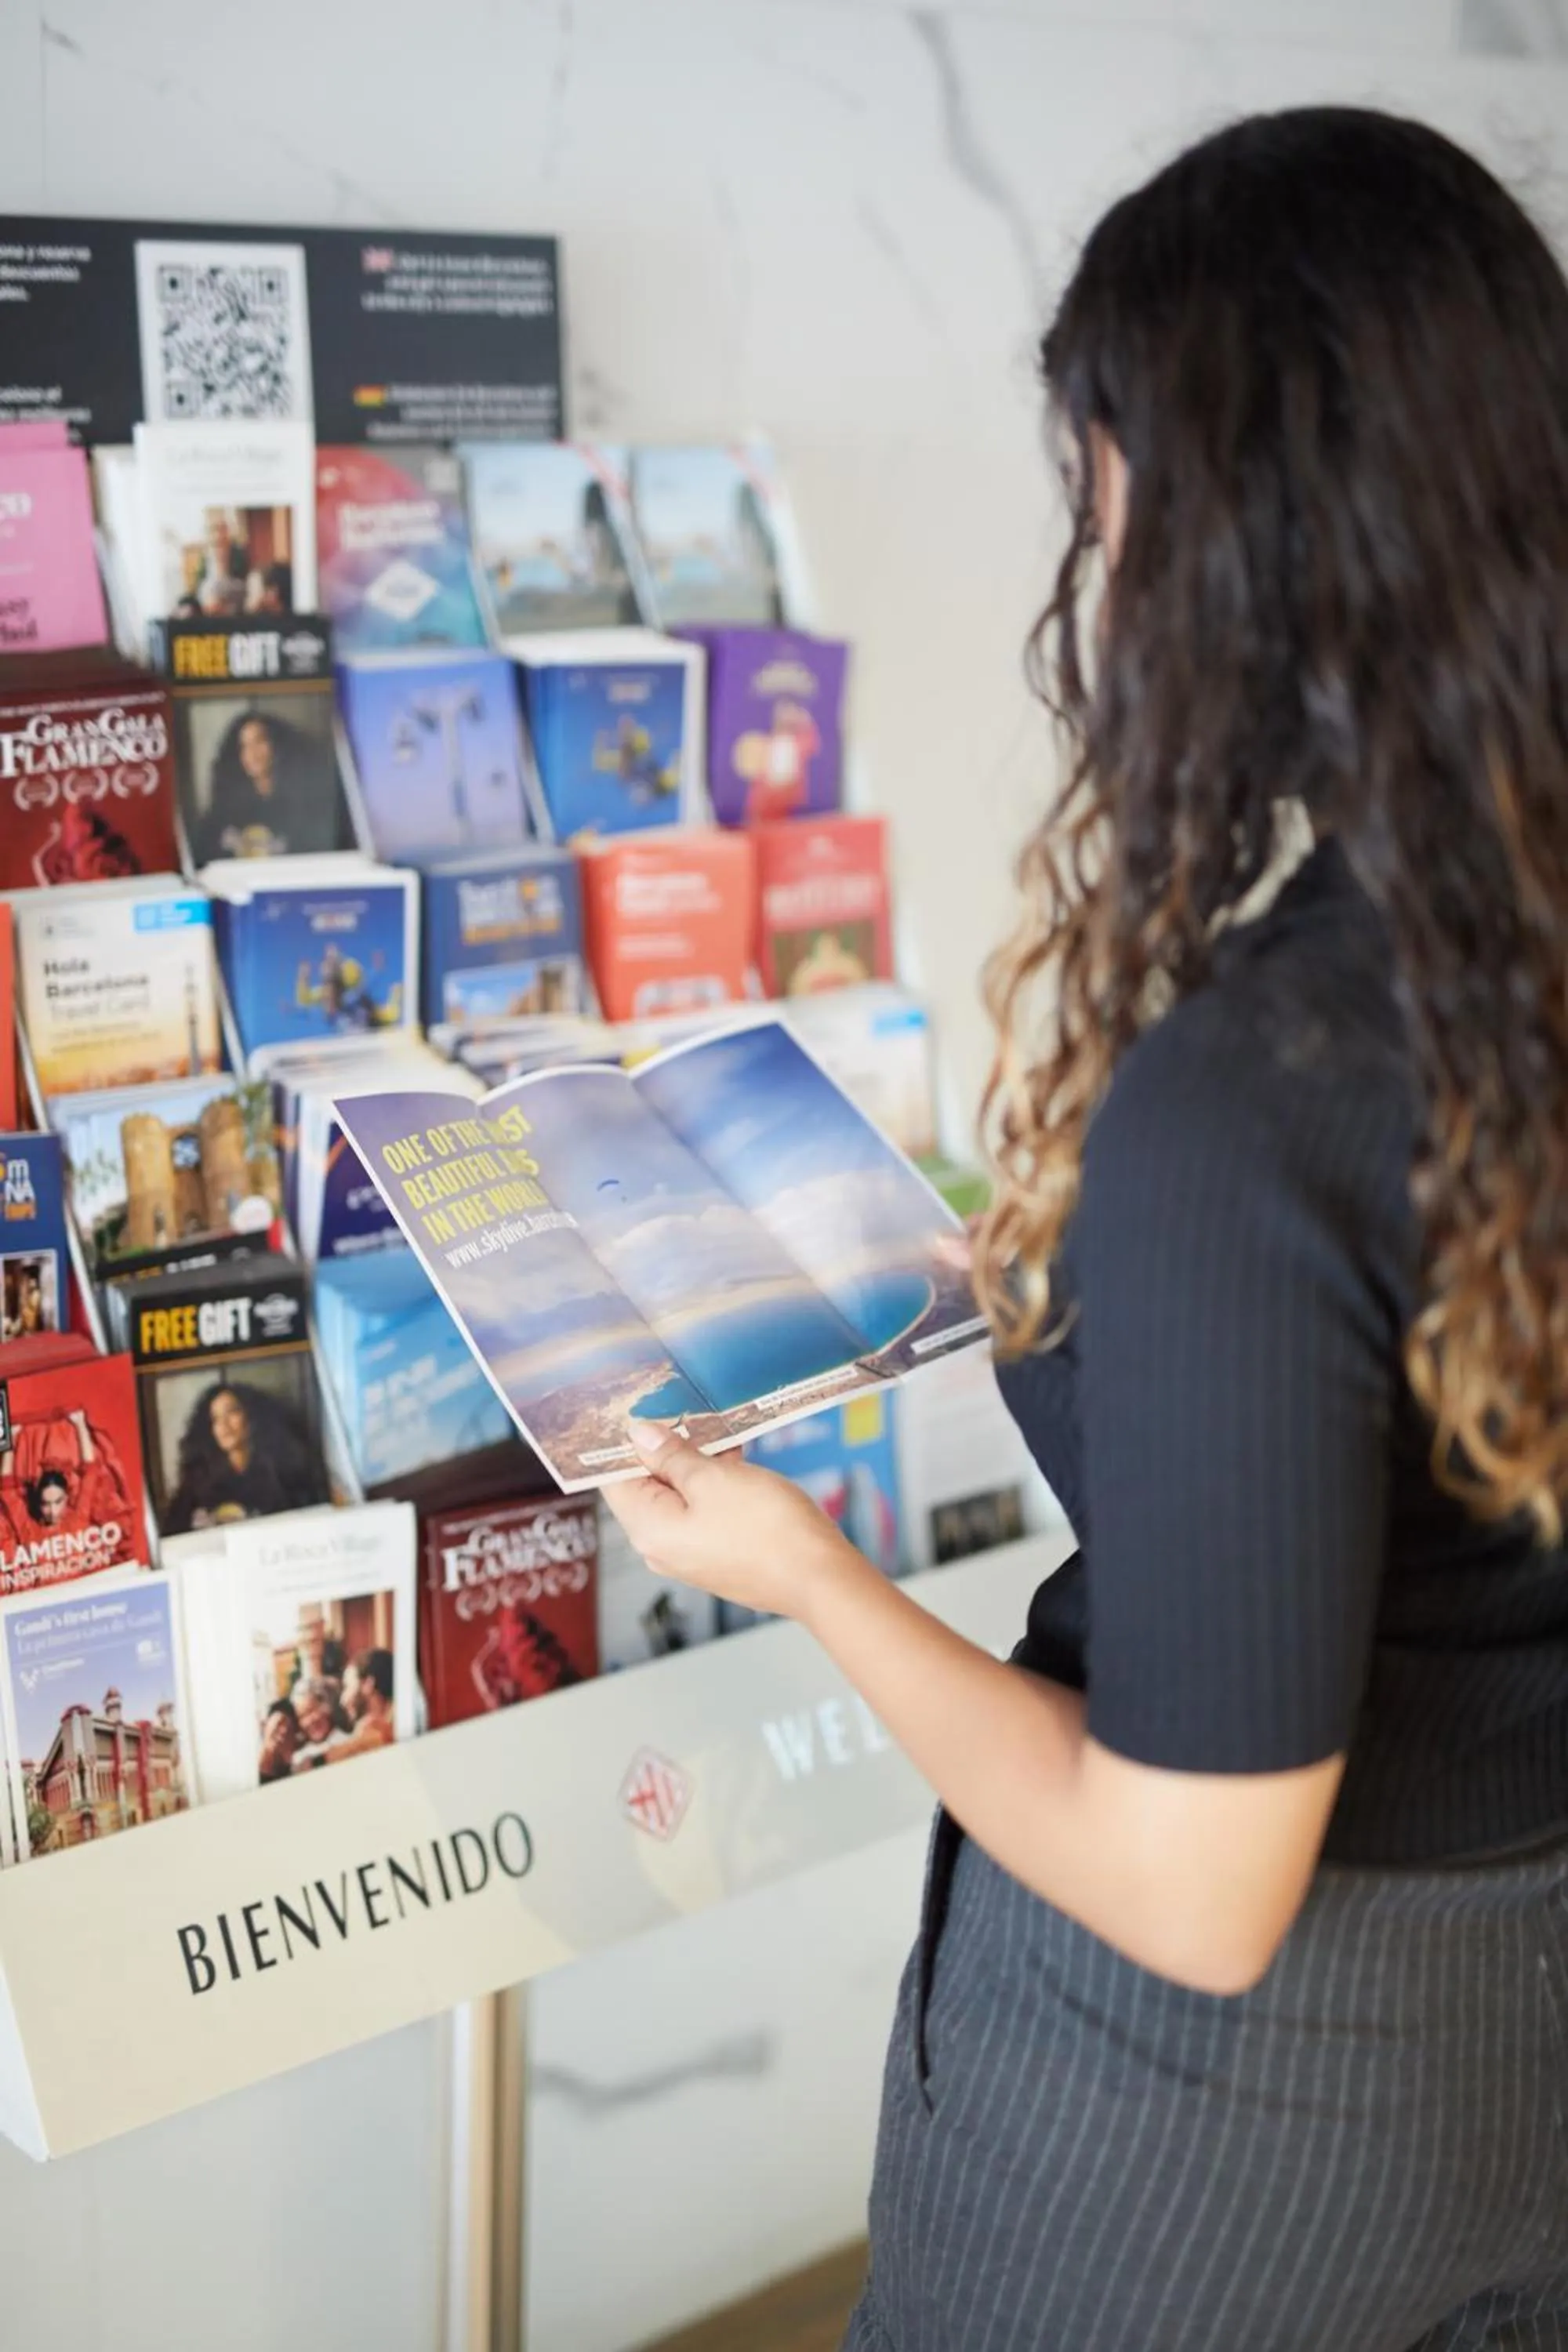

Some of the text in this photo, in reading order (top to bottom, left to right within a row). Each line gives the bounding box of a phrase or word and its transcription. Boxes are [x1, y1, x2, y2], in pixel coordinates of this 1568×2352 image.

[382, 1133, 433, 1174] ONE
[426, 1123, 457, 1156] OF
[448, 1118, 492, 1149] THE
[401, 1151, 507, 1210] BEAUTIFUL
[421, 1209, 457, 1245] IN
[447, 1192, 495, 1232] THE
[140, 1305, 198, 1355] FREE
[198, 1296, 252, 1347] GIFT
[0, 1521, 122, 1571] LAMENCO
[177, 1811, 535, 1995] BIENVENIDO
